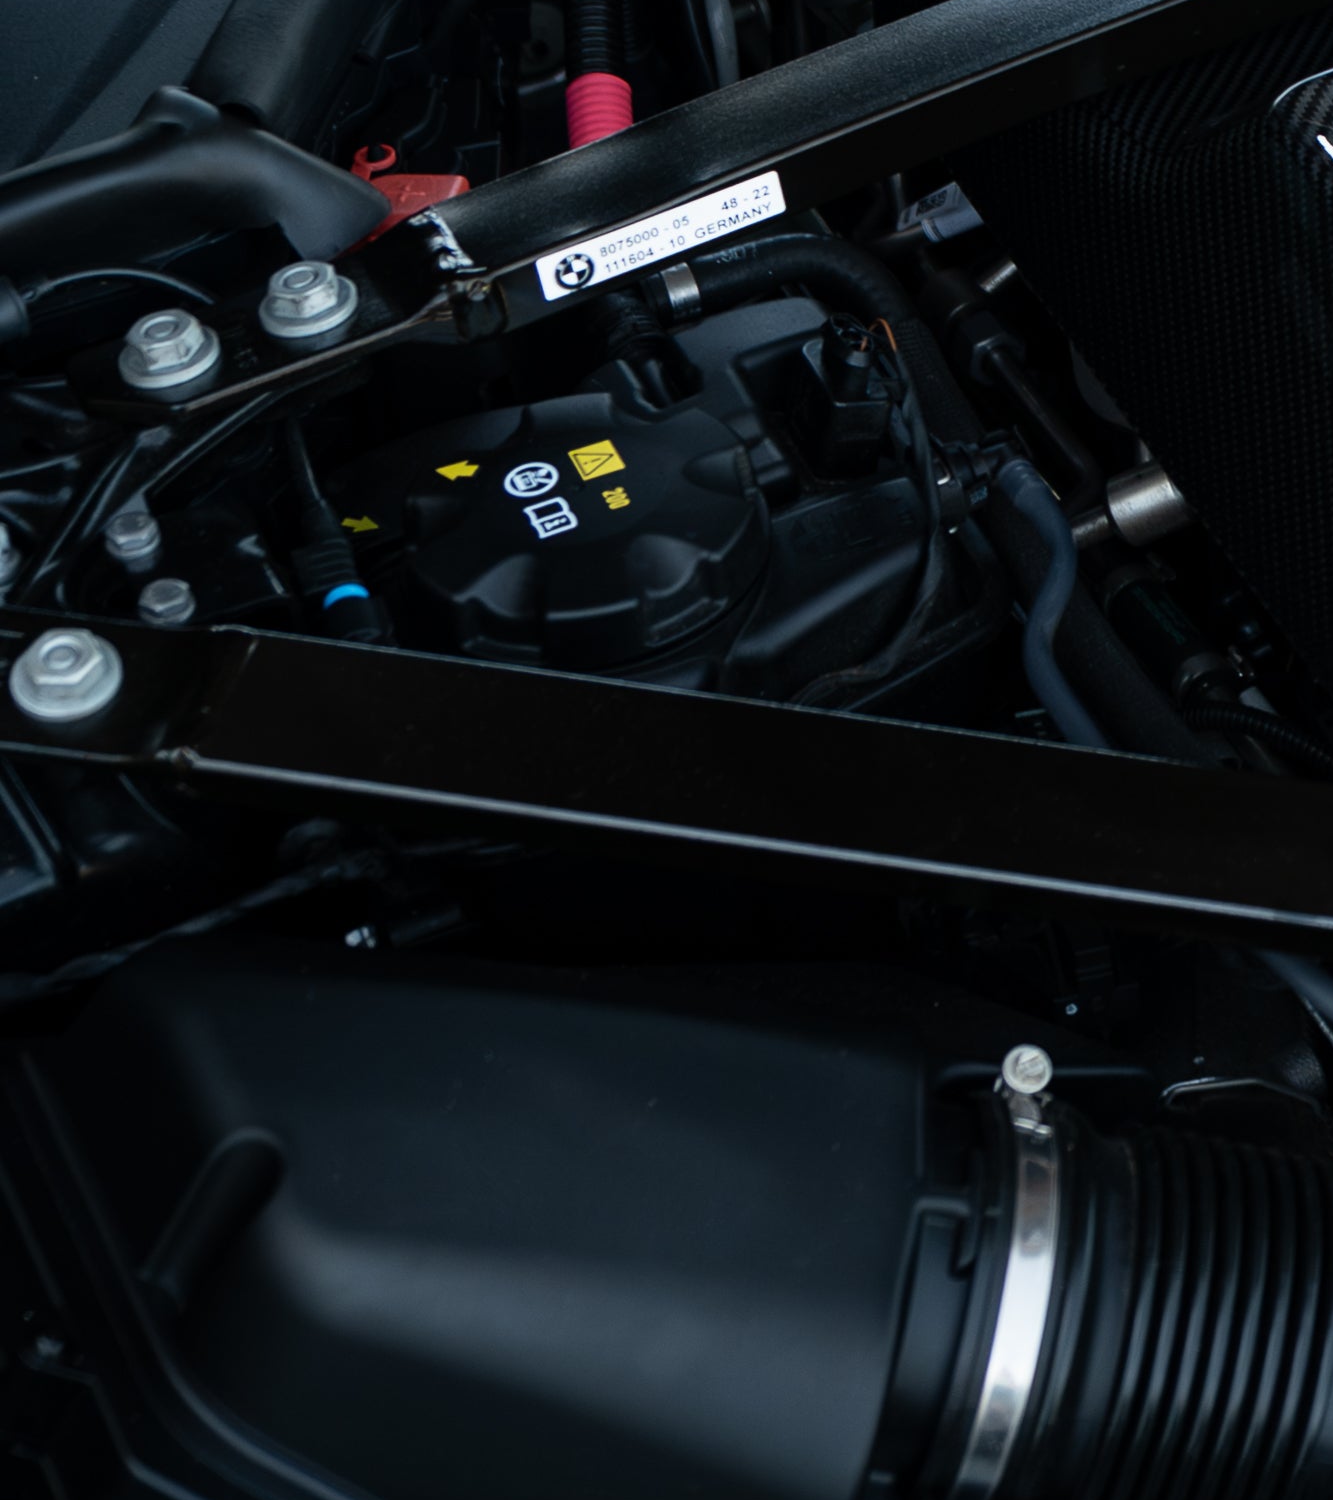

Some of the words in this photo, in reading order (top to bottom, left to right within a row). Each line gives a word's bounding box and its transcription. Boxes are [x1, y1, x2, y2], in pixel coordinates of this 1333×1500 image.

[600, 226, 659, 258] 8075000
[672, 215, 690, 230] 05
[720, 197, 738, 211] 48
[752, 185, 770, 200] 22
[670, 235, 686, 249] 10
[694, 201, 772, 240] GERMANY
